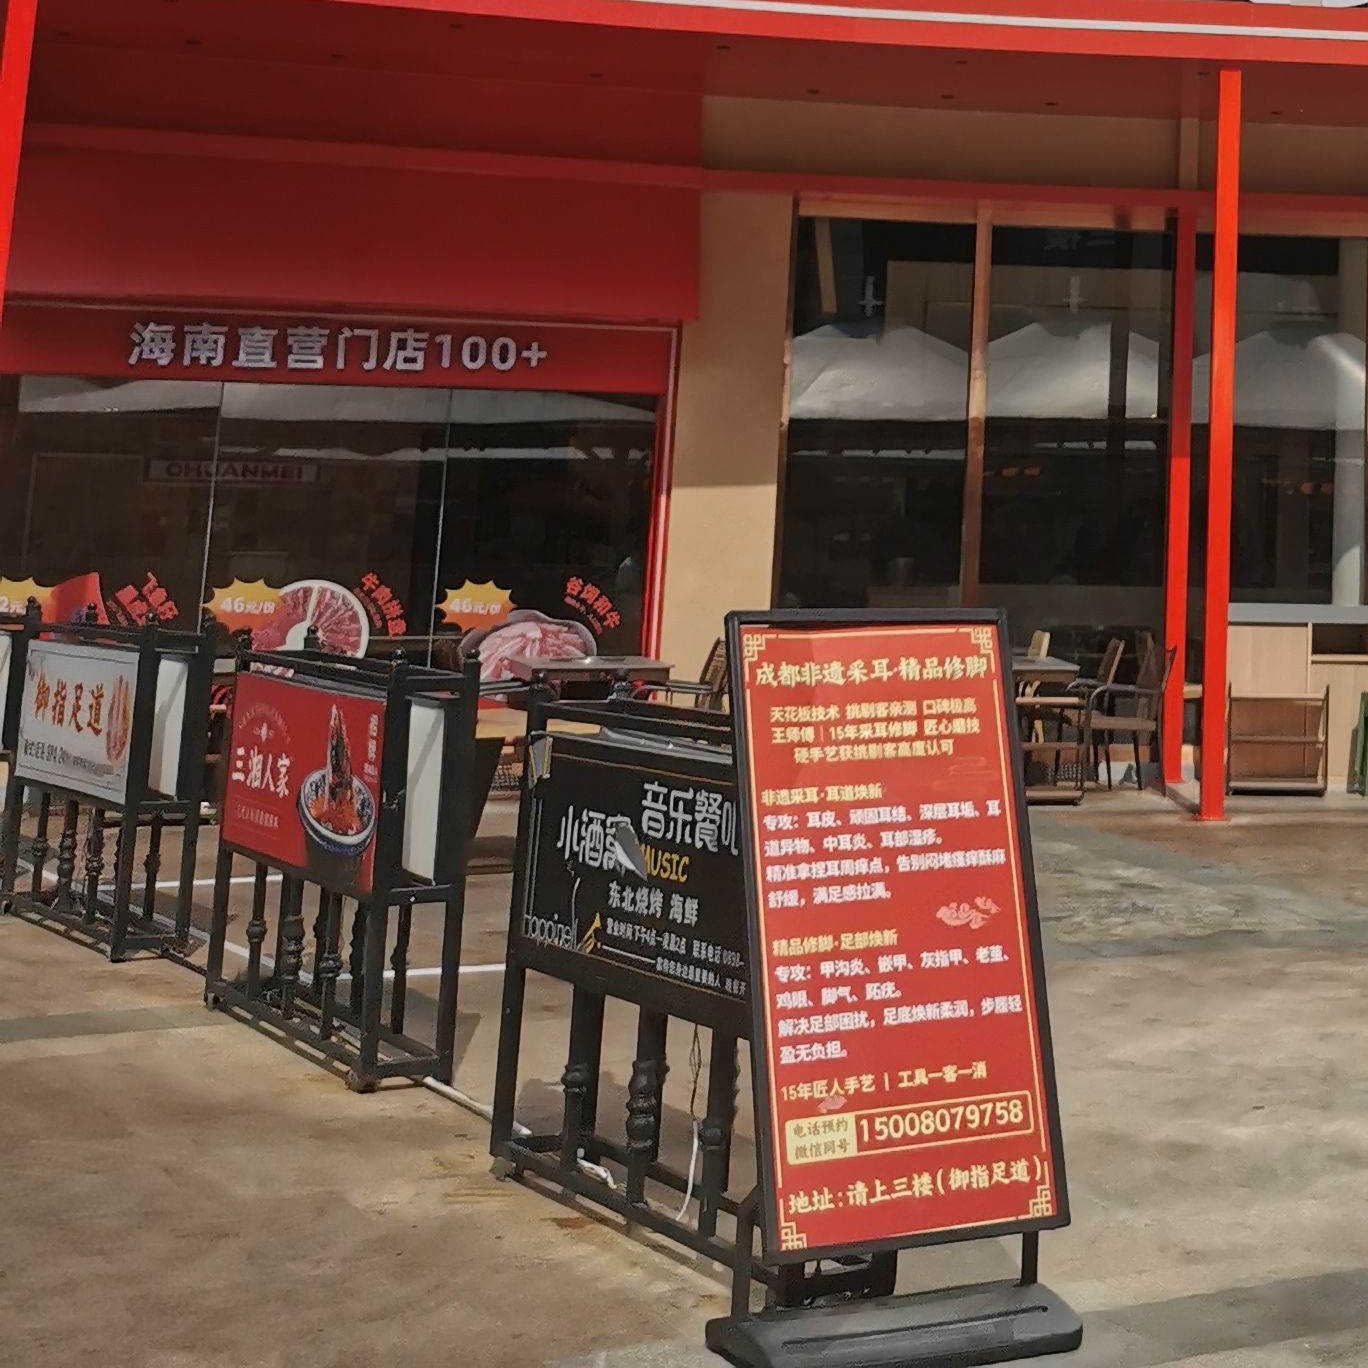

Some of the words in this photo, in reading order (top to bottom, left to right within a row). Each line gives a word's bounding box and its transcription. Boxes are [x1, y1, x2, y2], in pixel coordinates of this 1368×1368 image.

[128, 321, 547, 372] 海南直营门店100+
[34, 671, 104, 737] 御指足道
[641, 843, 690, 883] MUSIC
[608, 881, 664, 919] 东北烧烤
[668, 893, 699, 928] 海鲜
[860, 1099, 1023, 1142] 15008079758
